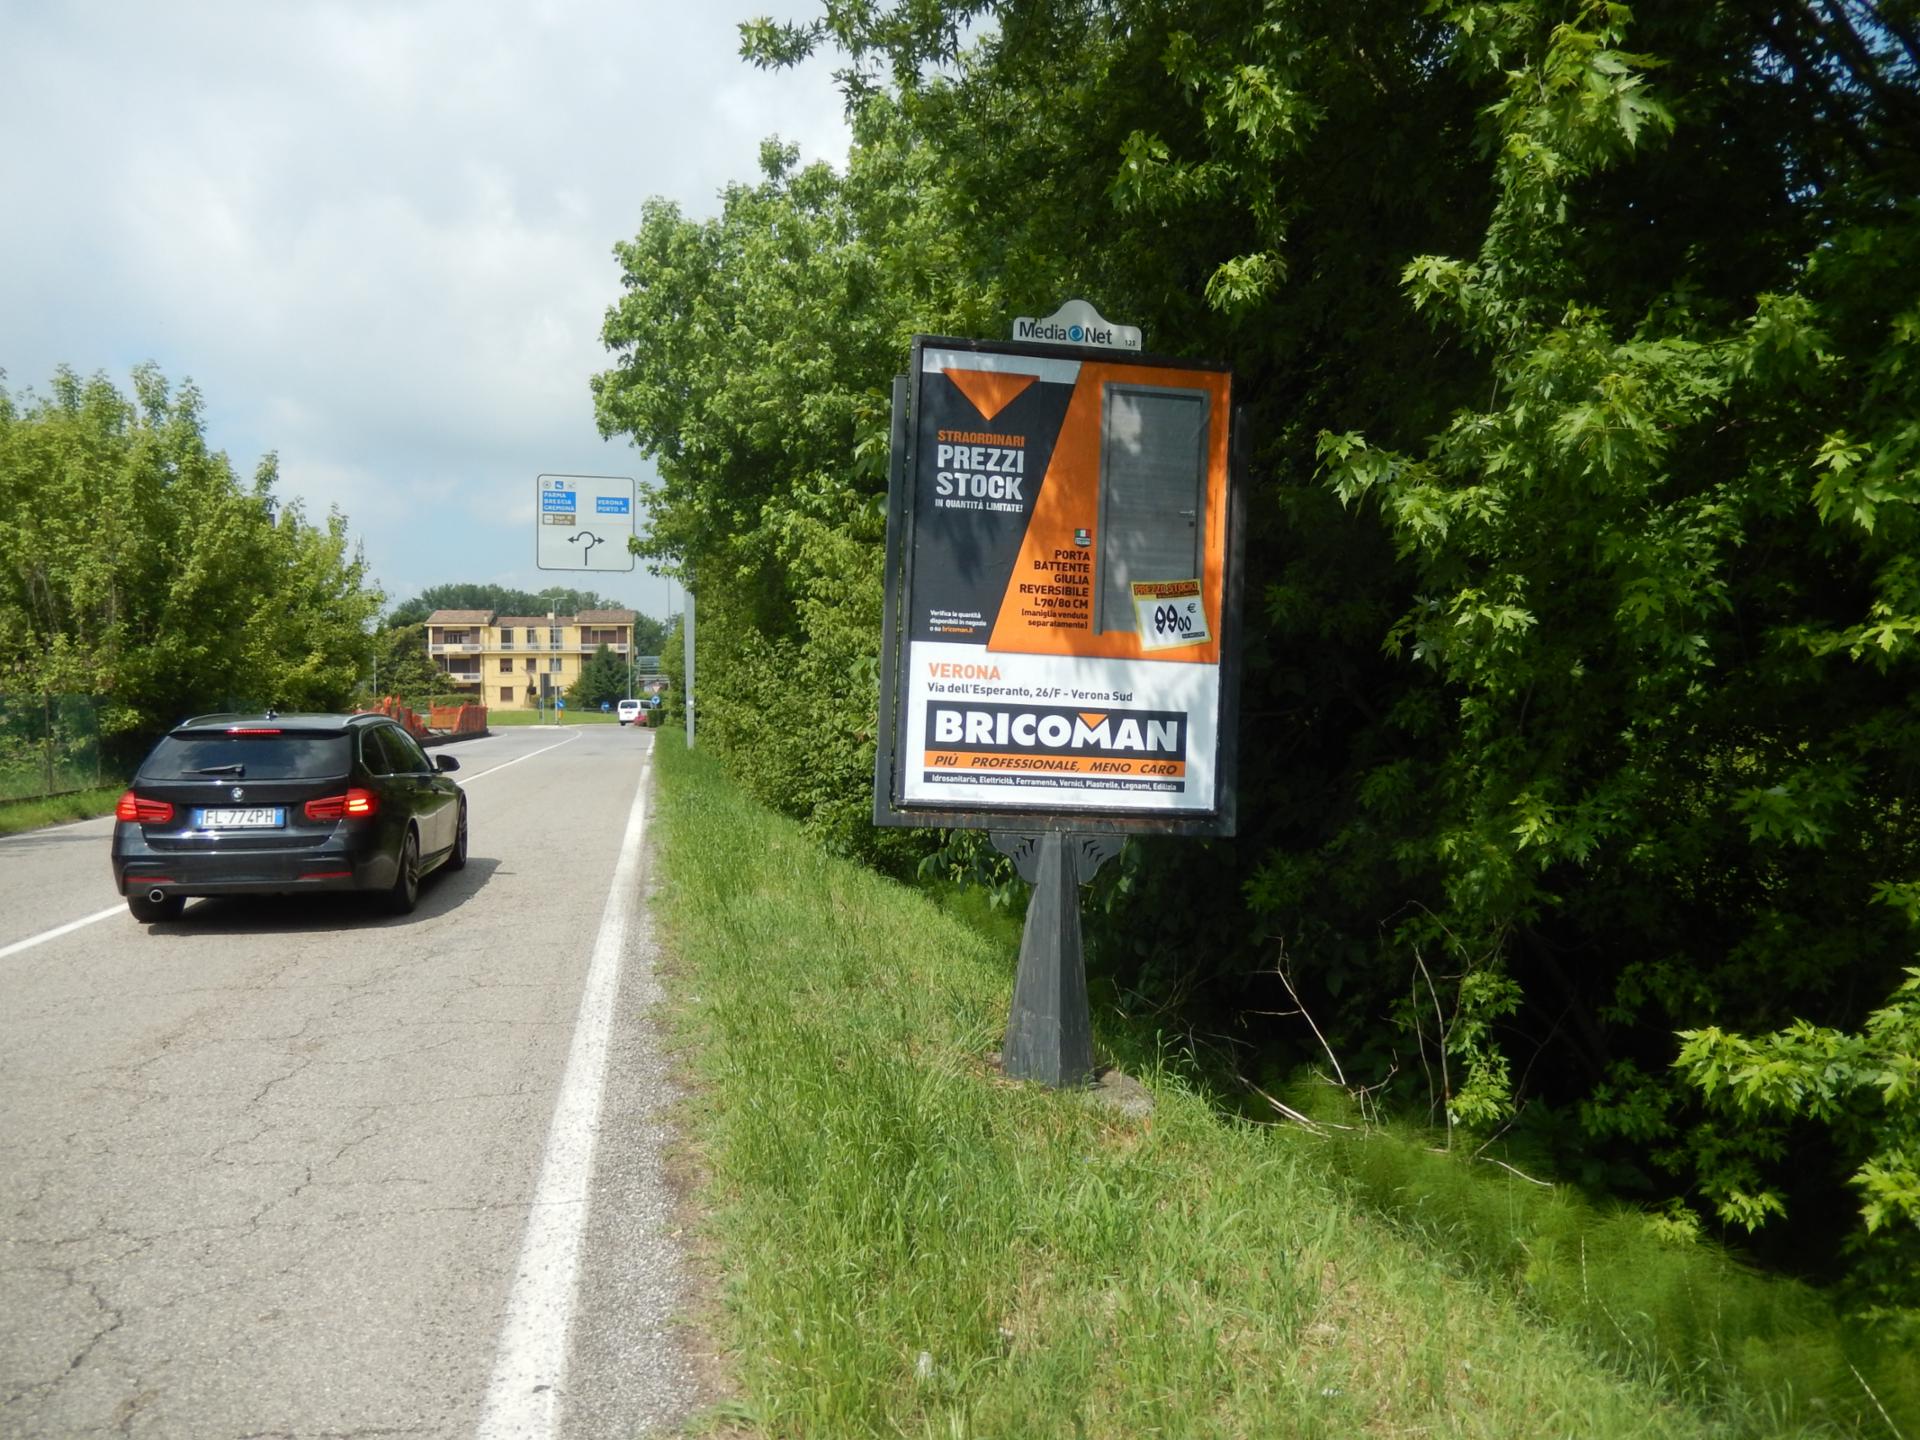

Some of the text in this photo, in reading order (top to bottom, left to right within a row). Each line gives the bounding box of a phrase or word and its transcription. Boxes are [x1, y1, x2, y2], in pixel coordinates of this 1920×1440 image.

[1019, 321, 1112, 345] Media Net
[937, 430, 1025, 448] STRAORDINARI
[937, 444, 1024, 473] PREZZI
[936, 471, 1023, 500] STOCK
[935, 499, 943, 507] IN
[986, 502, 1023, 513] LIMITATE!
[1055, 550, 1090, 561] PORTA
[1034, 560, 1090, 573] BATTENTE
[1054, 573, 1089, 585] GIULIA
[1019, 584, 1089, 597] REVERSIBILE
[1034, 598, 1088, 609] L70/80 CM
[1057, 610, 1088, 620] venduta
[928, 662, 1001, 680] VERONA
[928, 682, 945, 693] Via
[947, 683, 1033, 698] dell'Esperanto,
[1035, 687, 1061, 699] 26/F
[1071, 689, 1110, 700] Verona
[1112, 690, 1133, 702] Sud
[934, 709, 1178, 752] BRICOMAN
[934, 752, 1177, 775] PIÙ PROFESSIONALE, MENO CARO
[931, 774, 978, 784] Idrosanitaria,
[1016, 777, 1058, 787] Ferramenta,
[1060, 779, 1085, 788] Vernici,
[1086, 780, 1120, 789] Piastrelle,
[1121, 781, 1152, 791] Legnami,
[1153, 782, 1177, 791] Edilizia
[205, 810, 223, 825] FL
